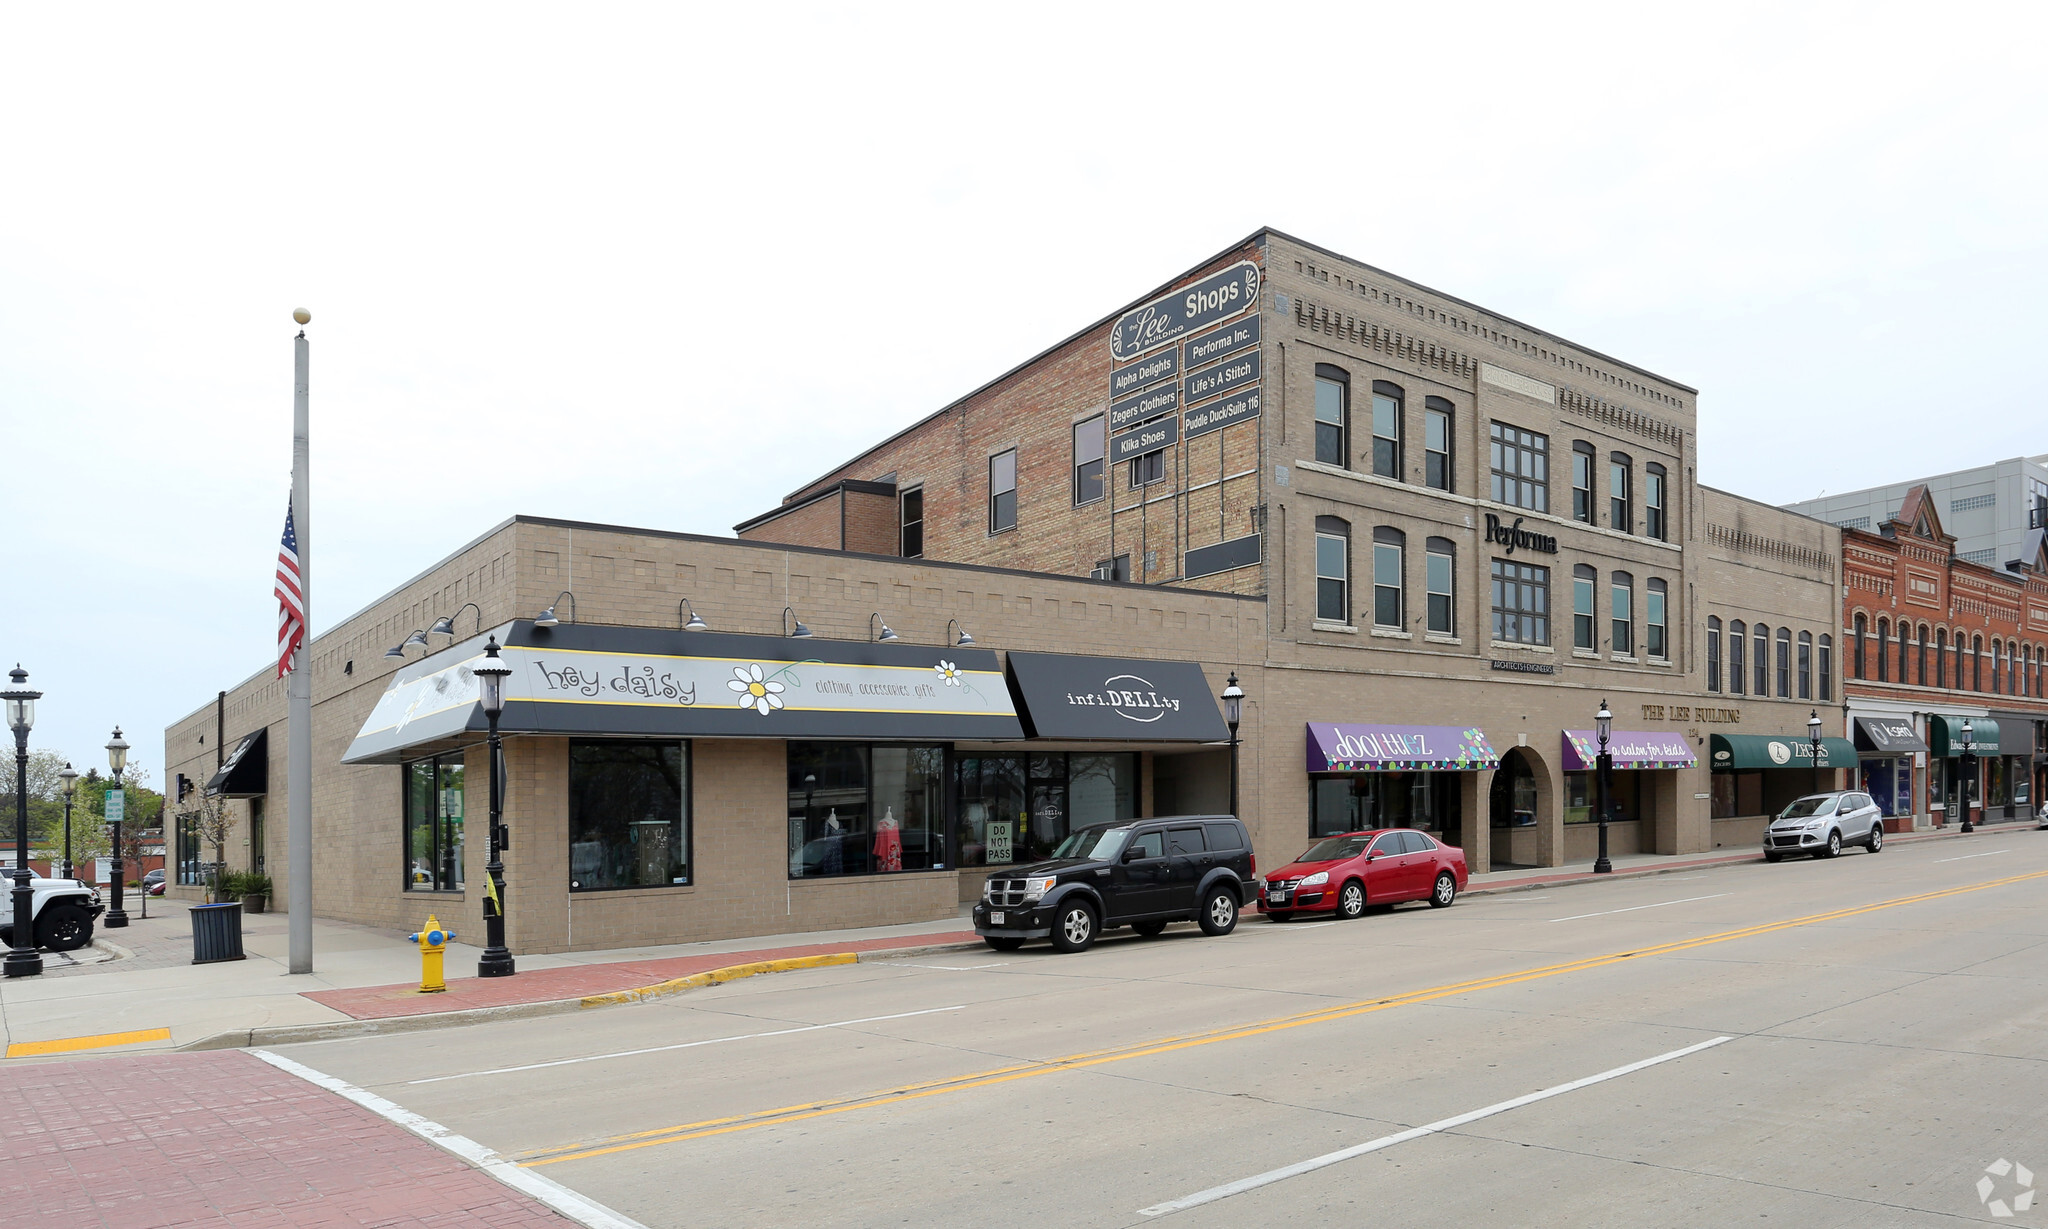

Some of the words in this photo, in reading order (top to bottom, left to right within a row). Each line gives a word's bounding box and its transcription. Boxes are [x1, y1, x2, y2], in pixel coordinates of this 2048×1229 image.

[1127, 306, 1171, 350] Lee
[1186, 280, 1239, 319] Shops
[1145, 324, 1184, 346] BUILDING
[1192, 334, 1232, 360] Performa
[1234, 328, 1250, 343] Inc.
[1116, 374, 1137, 390] Alpha
[1139, 358, 1171, 379] Delights
[1192, 376, 1215, 394] Life's
[1217, 371, 1224, 386] A
[1225, 361, 1251, 382] Stitch
[1112, 408, 1138, 425] Zegers
[1140, 391, 1175, 413] Clothiers
[1185, 411, 1208, 432] Puddle
[1209, 401, 1246, 422] Duck/Suite
[1247, 395, 1259, 410] 116
[1121, 440, 1139, 454] Klika
[1141, 429, 1165, 447] Shoes
[1485, 513, 1558, 554] Performa
[610, 666, 696, 706] daisy
[815, 680, 853, 697] clothing
[1642, 704, 1664, 720] THE
[1669, 705, 1690, 721] LEE
[1695, 707, 1740, 723] BUILDING
[1611, 746, 1620, 756] a
[1620, 743, 1647, 756] salon
[1647, 742, 1663, 760] for
[1662, 743, 1686, 756] kids
[991, 838, 1008, 849] NOT
[993, 825, 1006, 836] DO
[988, 849, 1011, 859] PASS
